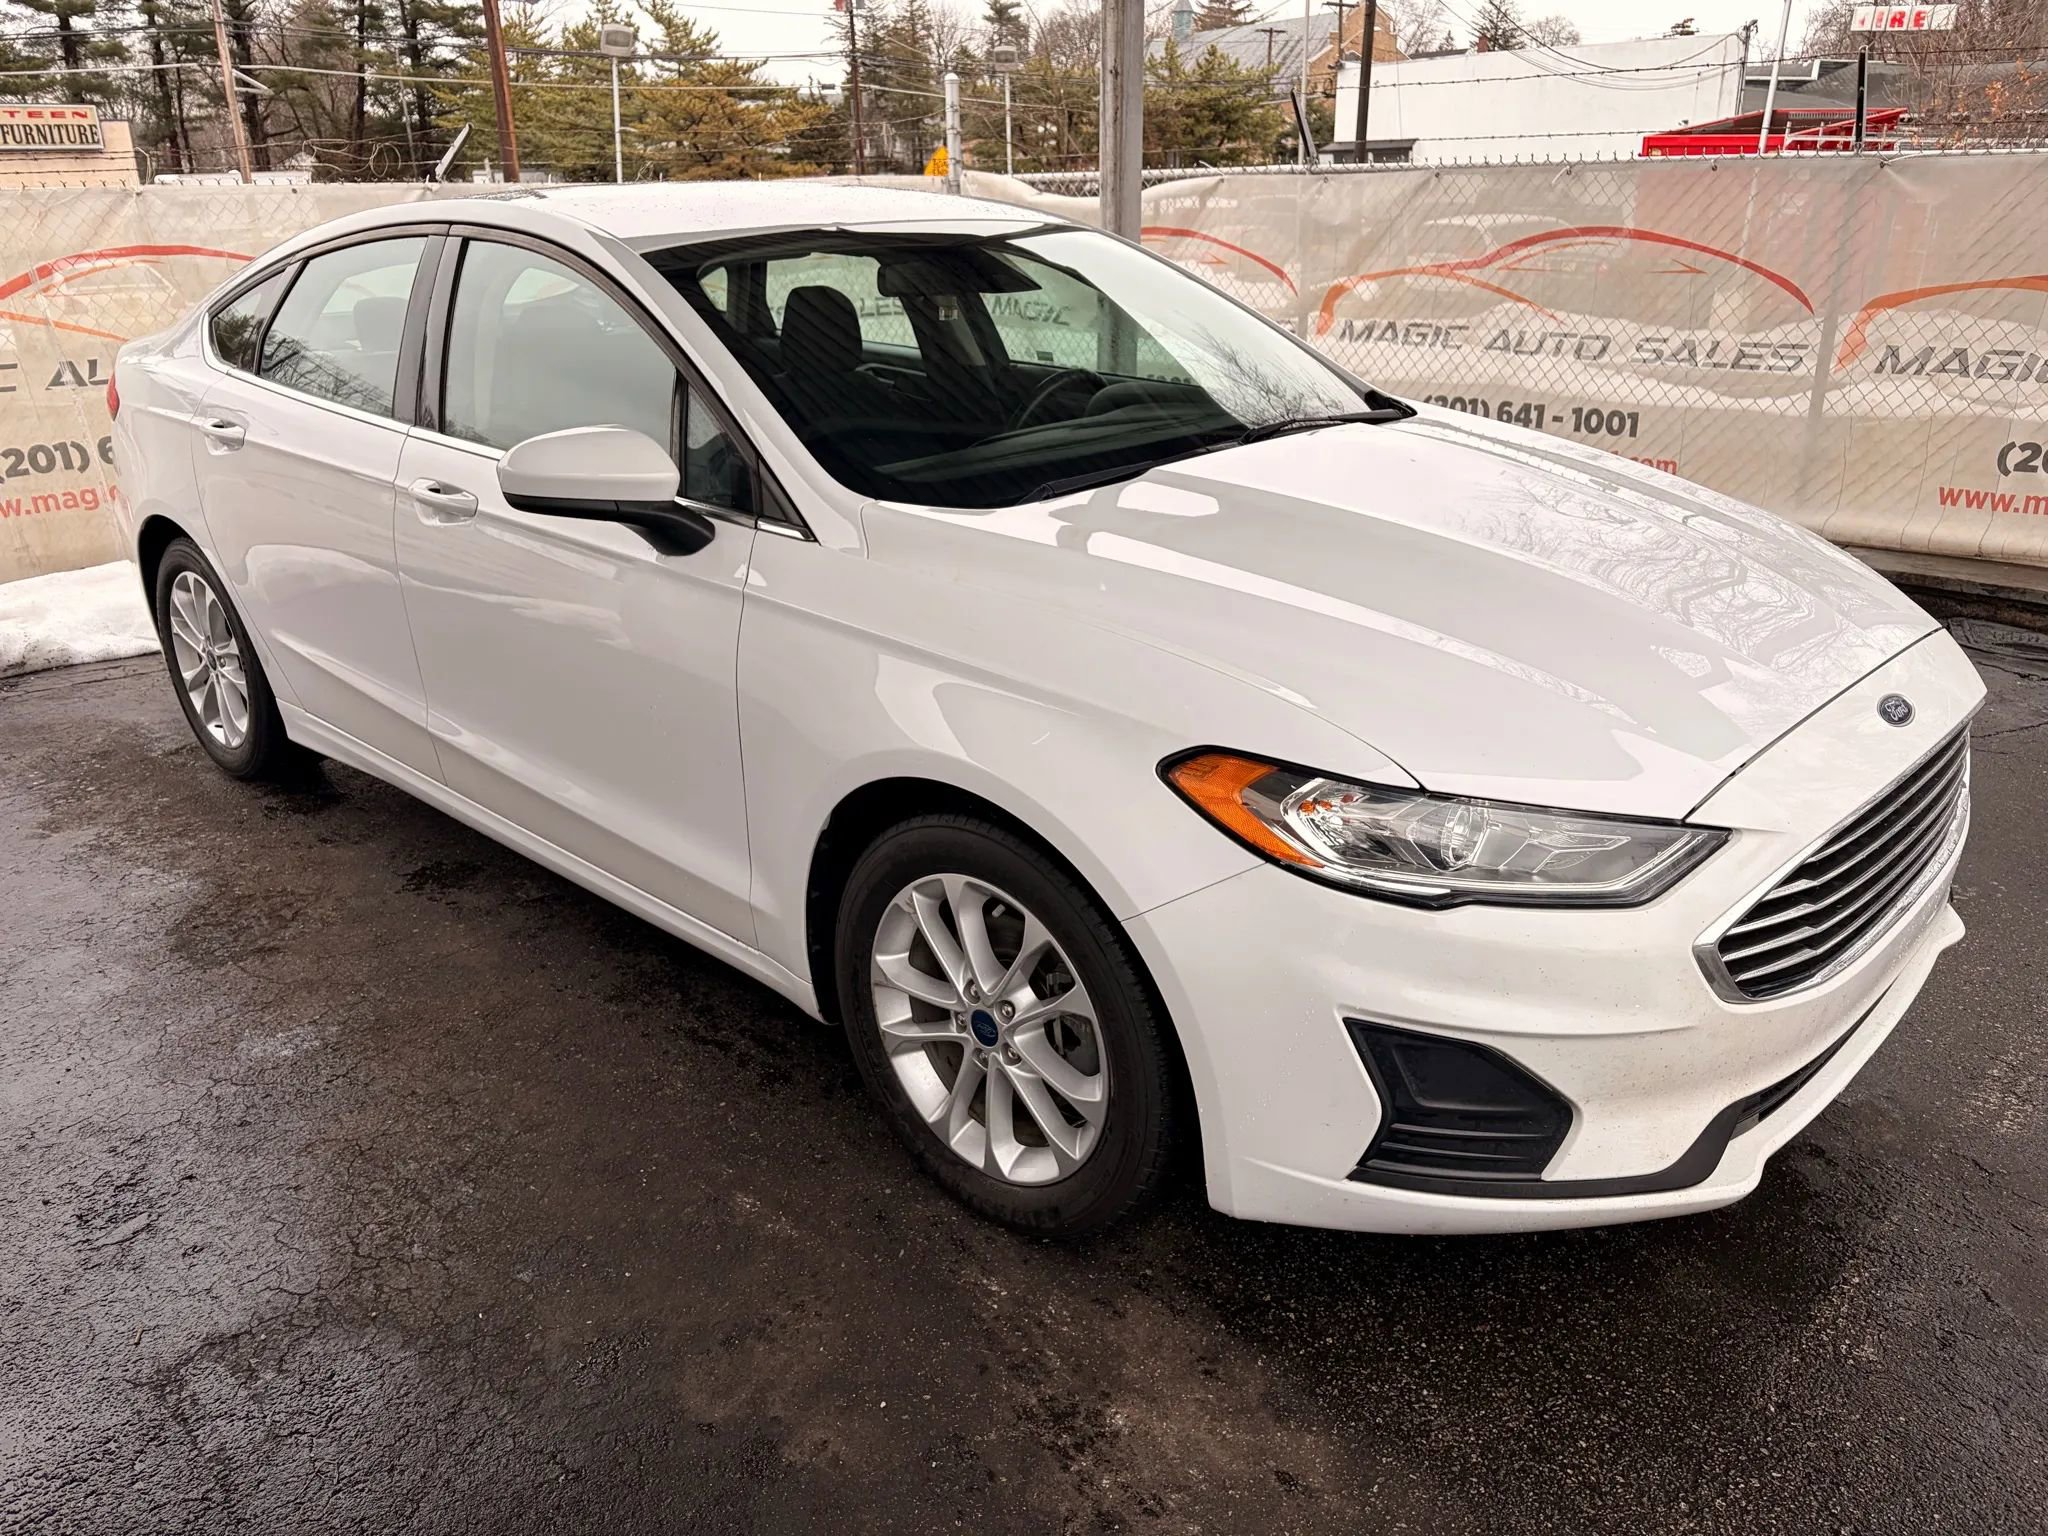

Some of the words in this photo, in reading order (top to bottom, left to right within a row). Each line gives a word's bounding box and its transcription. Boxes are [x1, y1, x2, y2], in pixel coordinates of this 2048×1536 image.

[1858, 10, 1927, 28] IRE
[2, 110, 88, 119] TEEN
[0, 123, 99, 145] FURNITURE
[1339, 319, 1470, 350] MAGIC
[1484, 329, 1611, 361] AUTO
[1630, 337, 1809, 372] SALES
[1497, 400, 1546, 429] 641
[1571, 407, 1639, 438] 1001
[0, 440, 90, 484] 201)
[1997, 441, 2048, 477] (2
